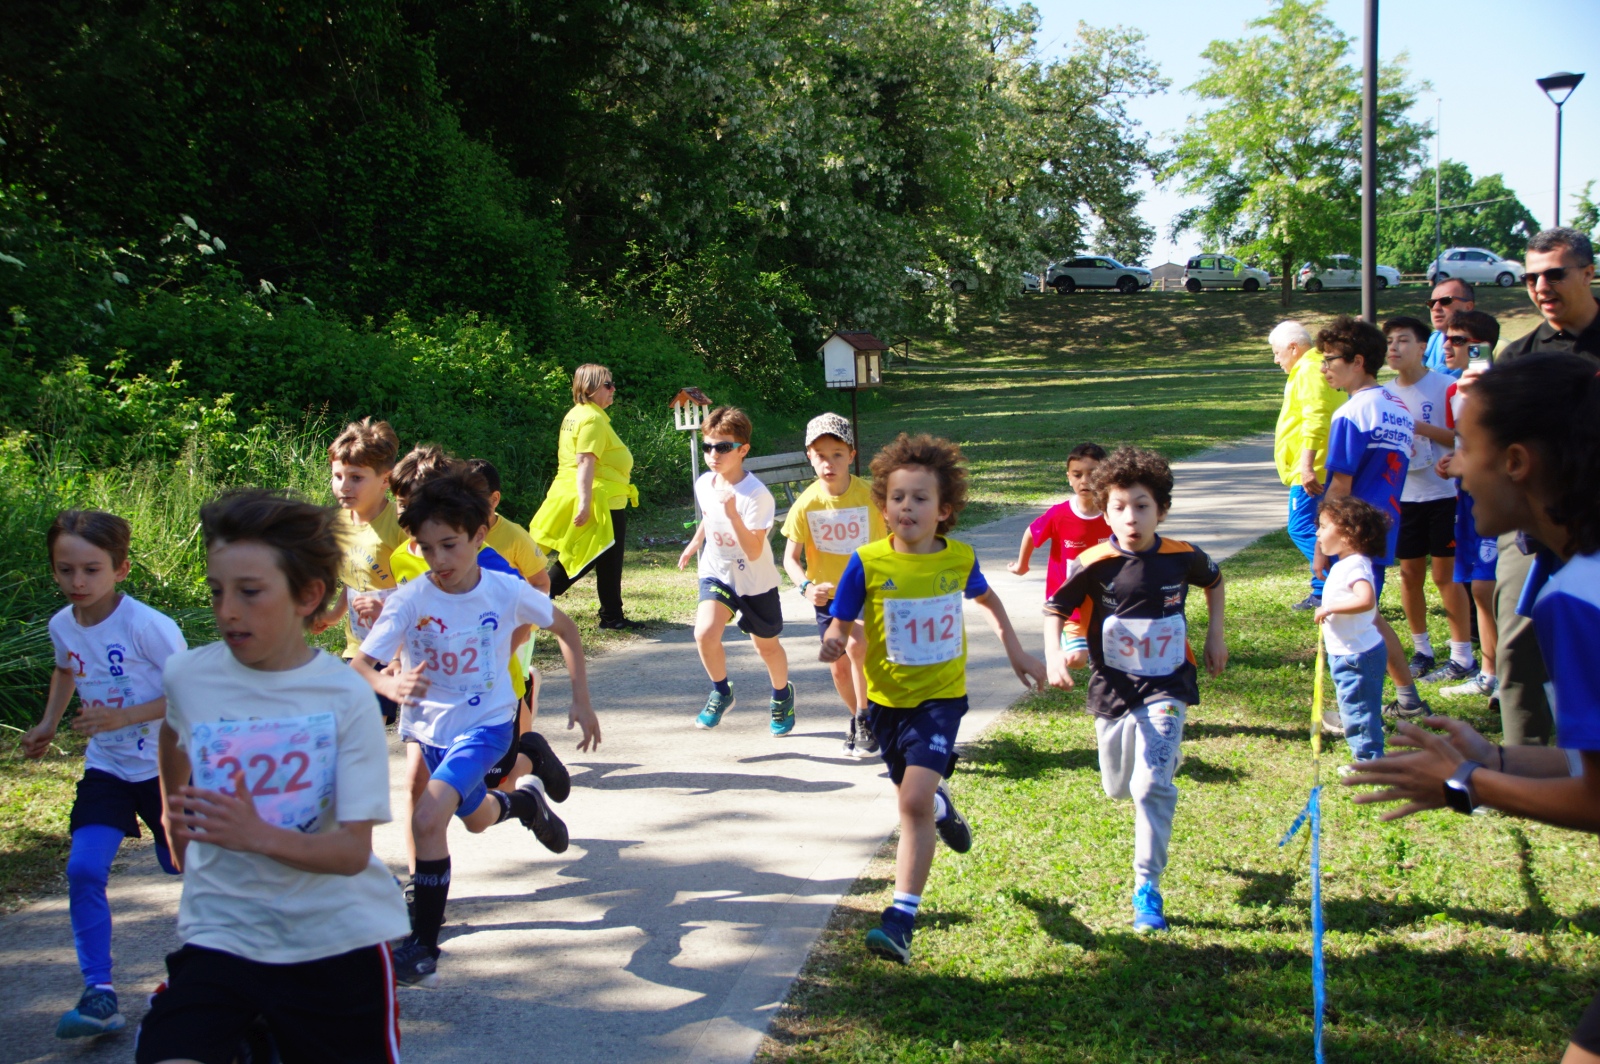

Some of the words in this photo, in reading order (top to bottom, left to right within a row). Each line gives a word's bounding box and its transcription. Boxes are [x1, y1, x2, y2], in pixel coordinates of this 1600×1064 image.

[820, 521, 860, 541] 209
[904, 614, 955, 645] 112
[423, 647, 480, 677] 392
[1118, 635, 1173, 659] 317
[216, 750, 313, 798] 322
